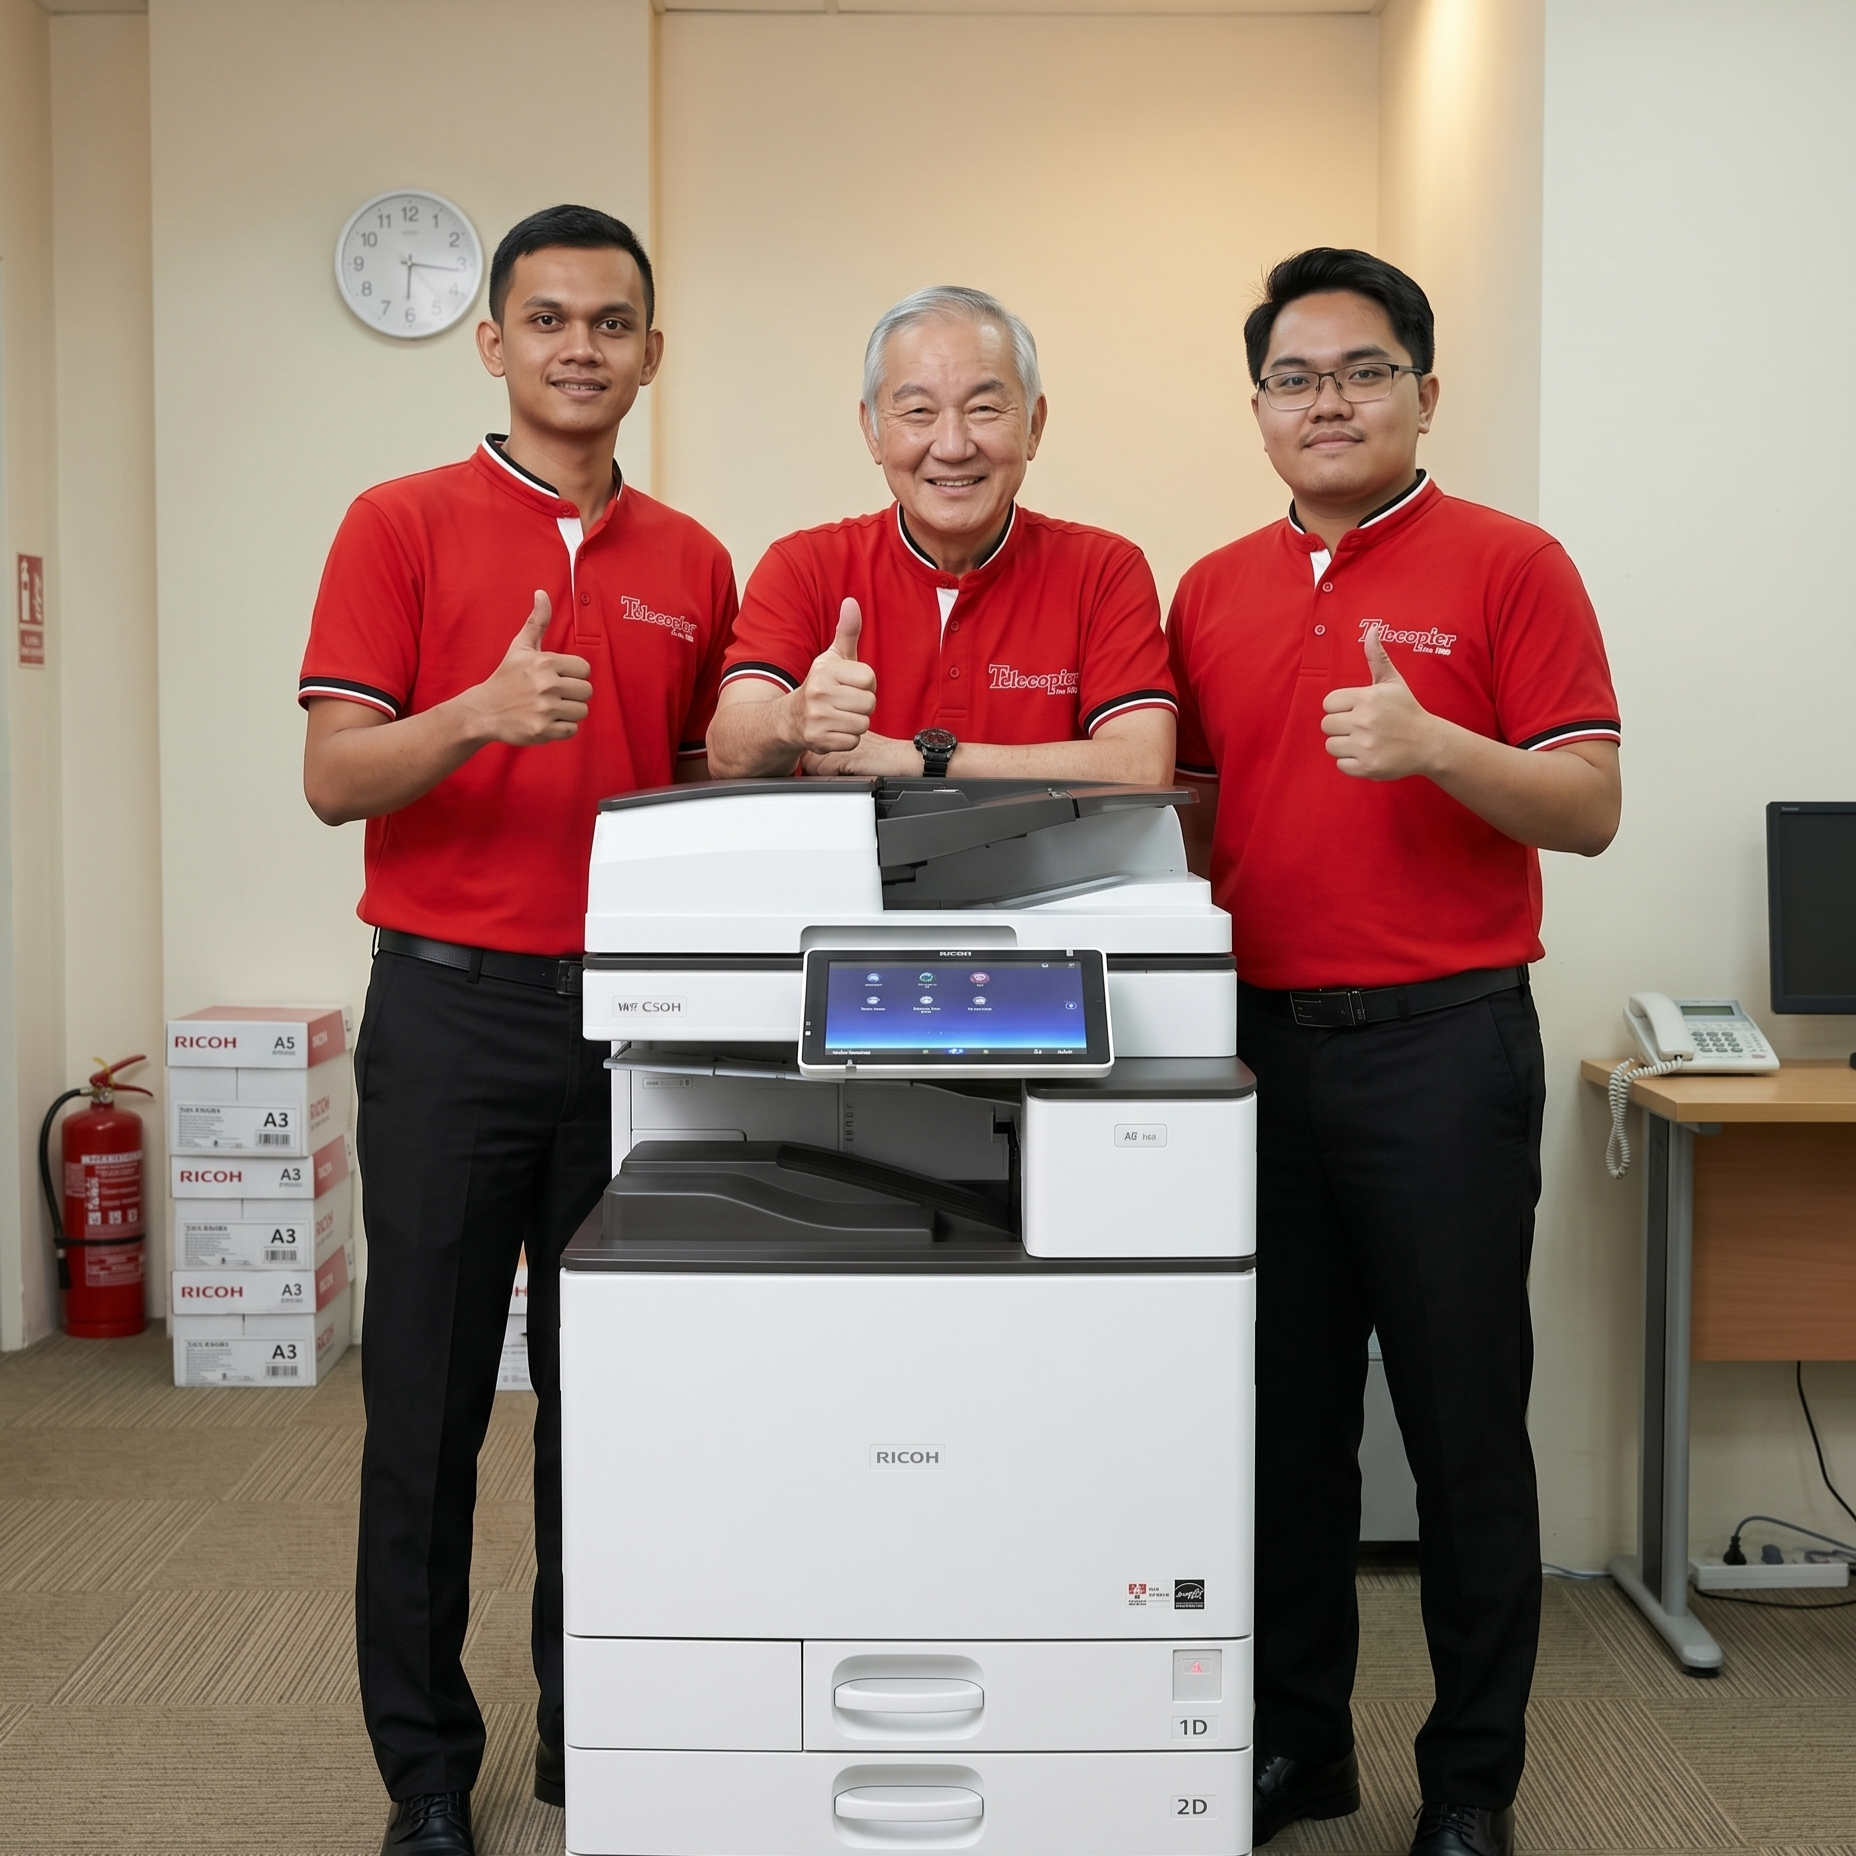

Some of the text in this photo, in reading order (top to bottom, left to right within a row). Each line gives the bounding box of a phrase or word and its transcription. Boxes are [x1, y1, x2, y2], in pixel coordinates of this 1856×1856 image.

[377, 213, 391, 229] 11
[401, 206, 419, 222] 12
[432, 213, 439, 229] 1
[361, 231, 378, 248] 10
[449, 232, 460, 248] 2
[353, 255, 365, 272] 9
[456, 257, 467, 272] 3
[361, 281, 372, 297] 8
[449, 282, 459, 297] 4
[380, 300, 391, 316] 7
[405, 307, 416, 323] 6
[431, 300, 442, 316] 5
[1358, 618, 1457, 652] Tlecopier
[988, 664, 1079, 695] Telecopier
[174, 1036, 237, 1049] RICOH
[274, 1036, 295, 1050] A5
[263, 1112, 289, 1128] A3
[180, 1170, 242, 1183] RICOH
[280, 1168, 301, 1181] A3
[271, 1228, 296, 1244] A3
[181, 1286, 243, 1298] RICOH
[281, 1283, 302, 1296] A3
[272, 1344, 297, 1360] A3
[876, 1451, 939, 1464] RICOH
[1179, 1719, 1208, 1736] 1D
[1177, 1798, 1208, 1815] 2D
